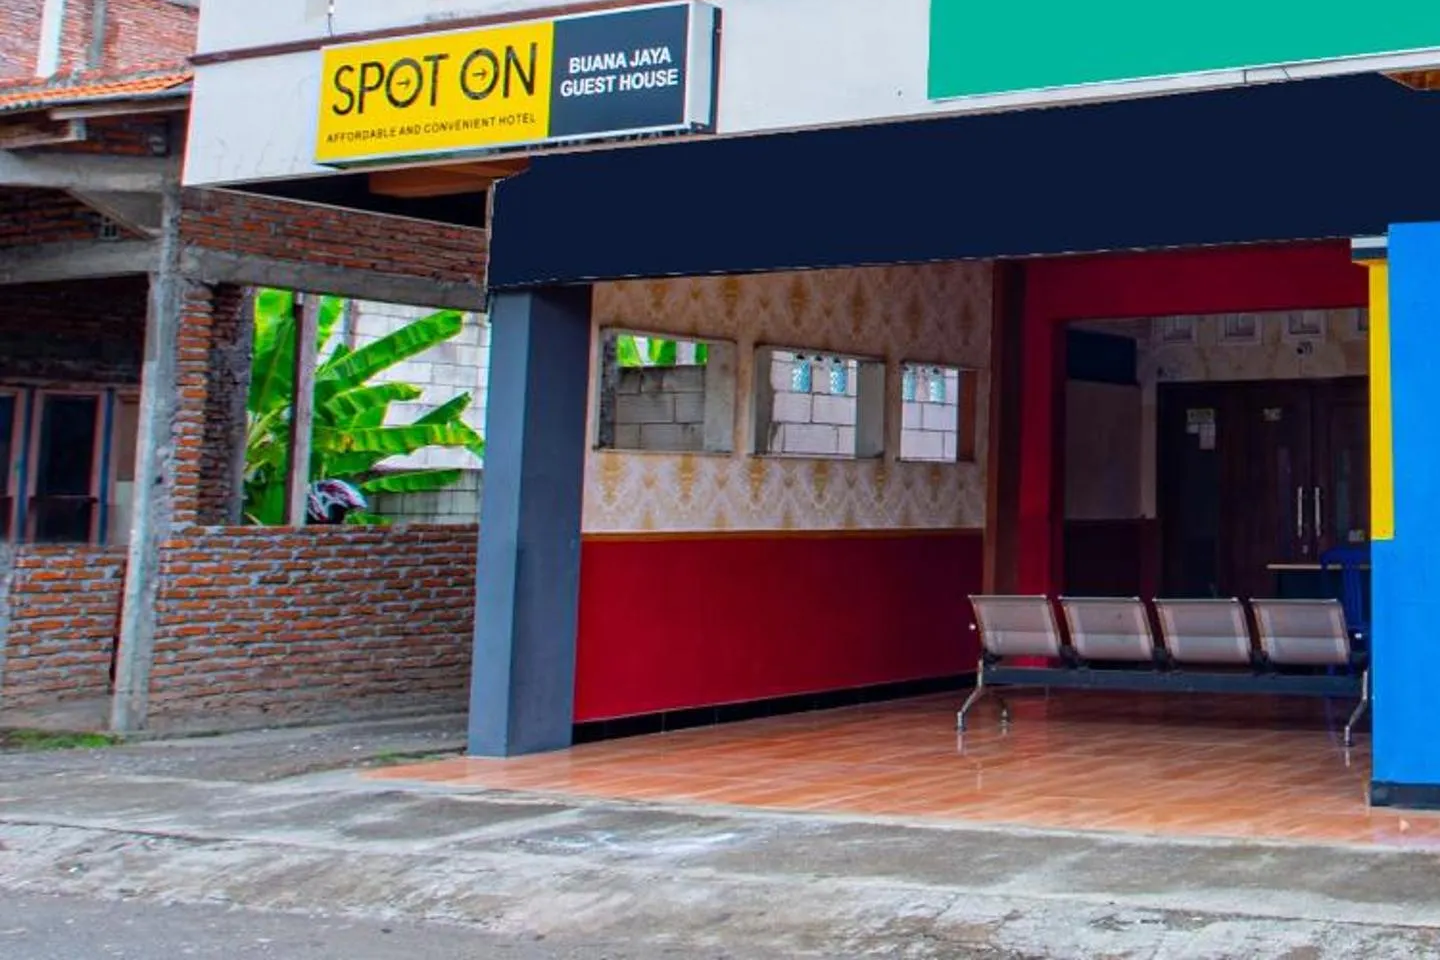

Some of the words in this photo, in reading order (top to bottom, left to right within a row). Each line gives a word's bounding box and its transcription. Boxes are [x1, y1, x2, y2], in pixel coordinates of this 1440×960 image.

[568, 52, 627, 74] BUANA
[629, 46, 672, 67] JAYA
[331, 53, 450, 116] SPOT
[459, 42, 538, 101] ON
[560, 74, 616, 97] GUEST
[619, 68, 679, 91] HOUSE
[326, 128, 396, 143] AFFORDABLE
[398, 124, 421, 136] AND
[423, 115, 496, 134] CONVENIENT
[498, 112, 536, 125] HOTEL
